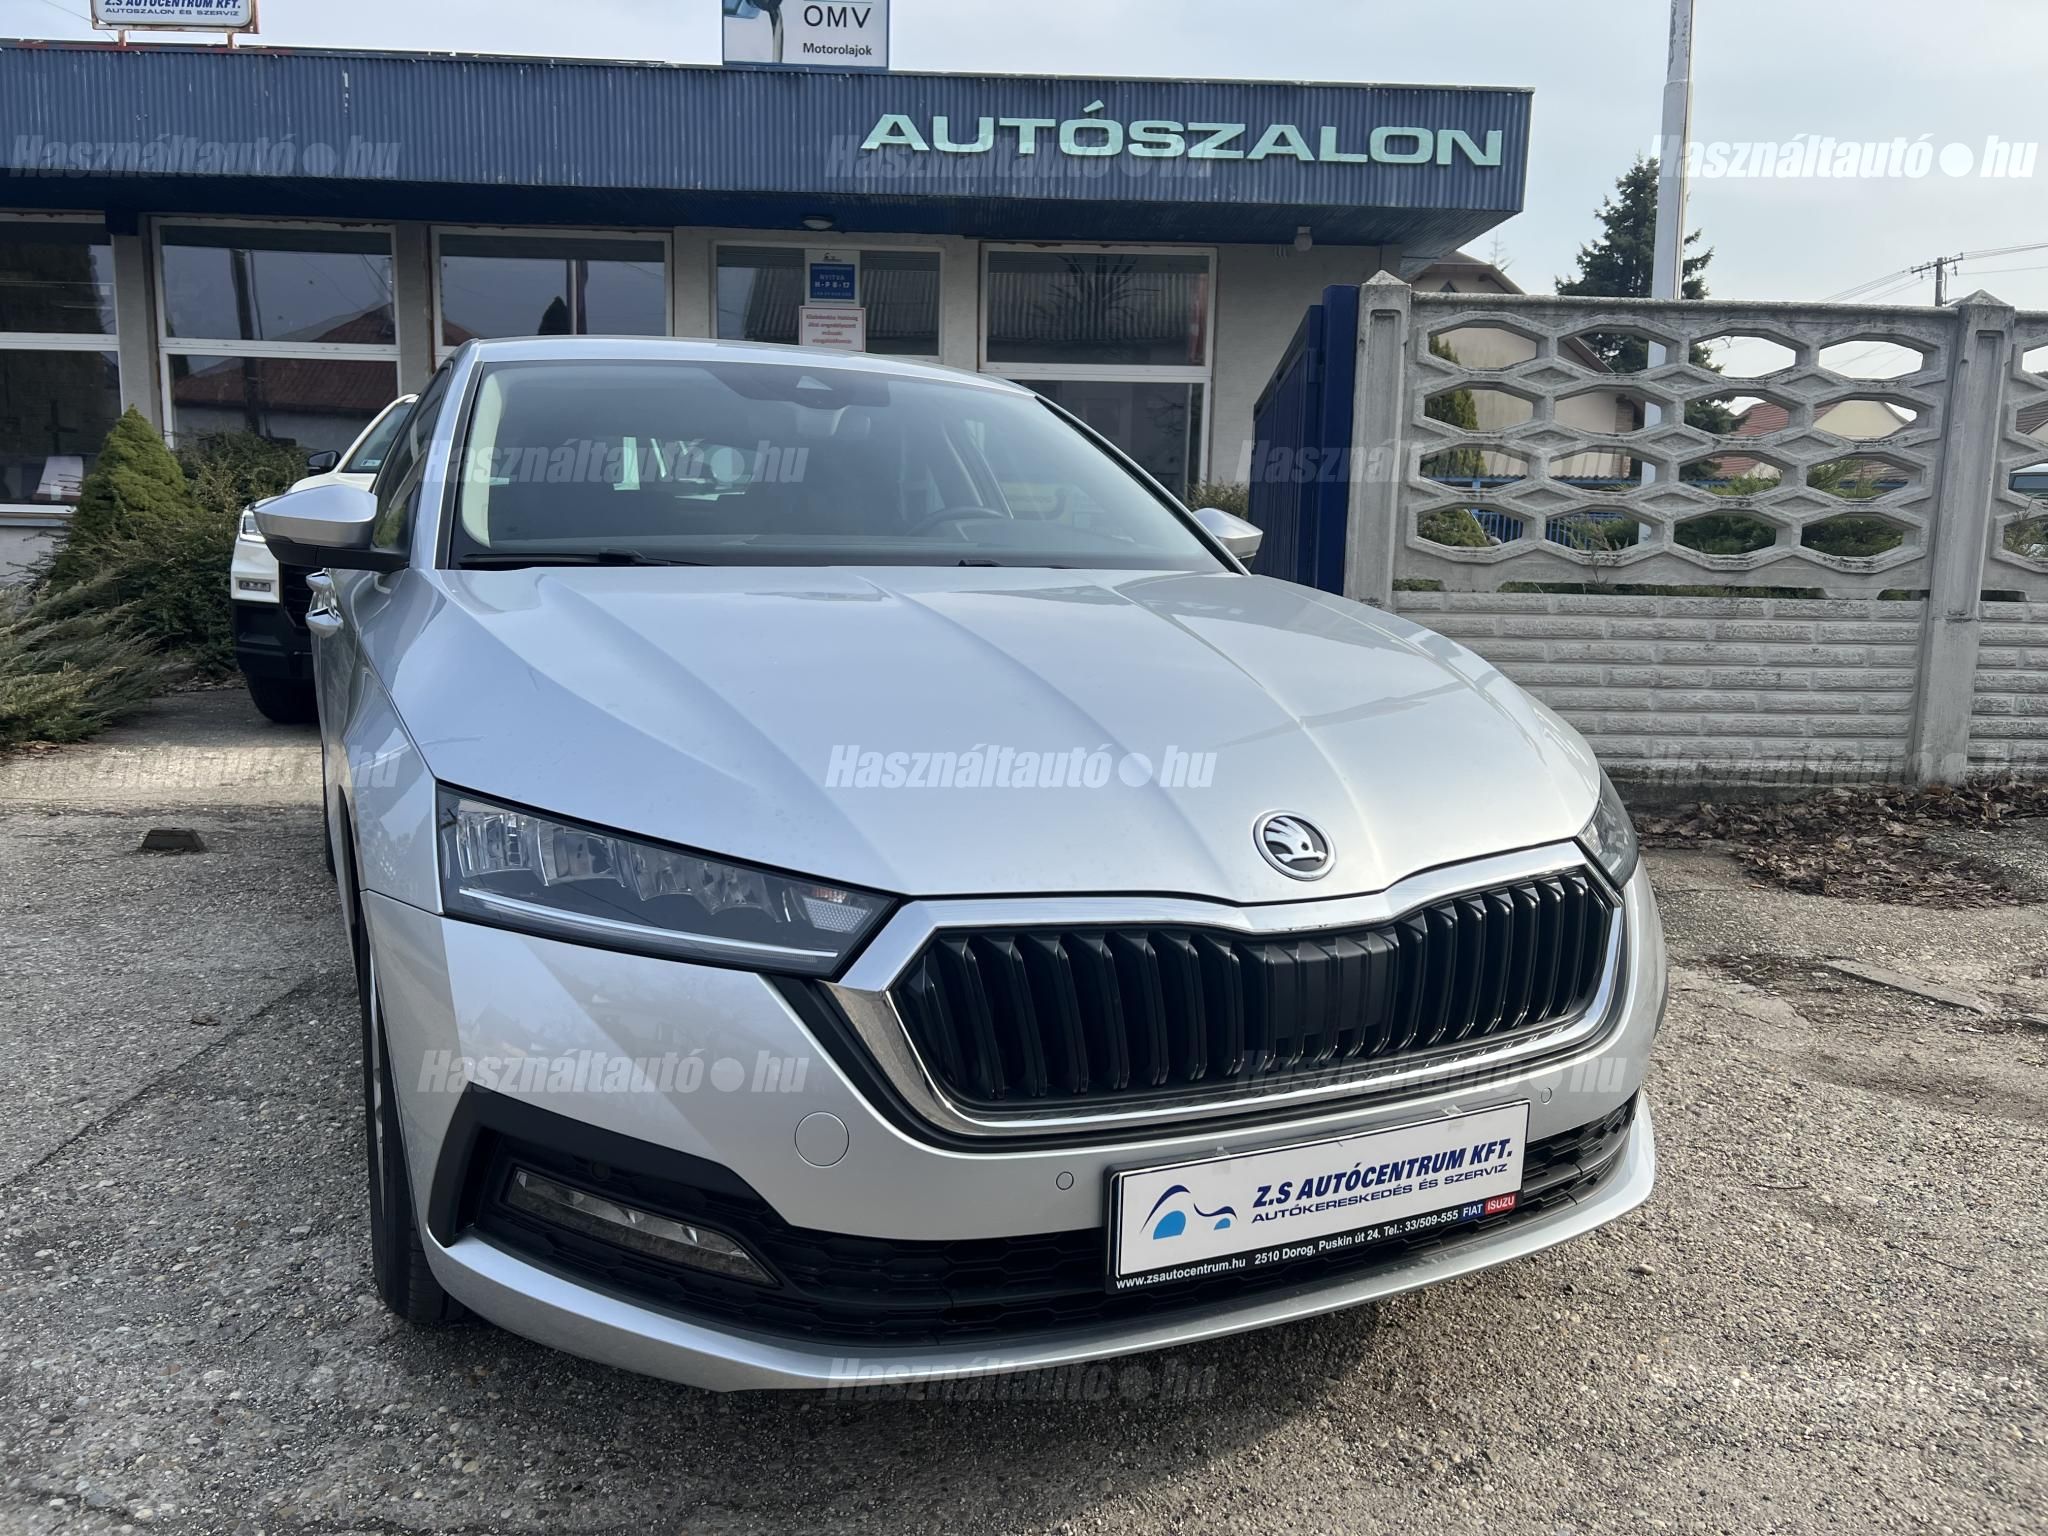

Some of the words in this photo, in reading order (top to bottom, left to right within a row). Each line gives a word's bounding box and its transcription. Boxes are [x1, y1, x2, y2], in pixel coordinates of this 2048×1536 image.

[803, 4, 872, 28] OMV
[803, 42, 873, 57] Motorolajok
[860, 99, 1503, 167] AUTÓSZALON
[1251, 1184, 1413, 1224] AUTÓKERESKEDÉS
[1418, 1178, 1439, 1191] ÉS
[1444, 1163, 1508, 1185] SZERVIZ
[1252, 1181, 1294, 1209] Z.S
[1296, 1147, 1467, 1199] AUTÓCENTRUM
[1469, 1138, 1513, 1166] KFT.
[1462, 1203, 1484, 1218] FIAT
[1487, 1195, 1516, 1210] ISUZU
[1116, 1257, 1247, 1290] www.zsautocentrum.hu
[1254, 1250, 1280, 1265] 2510
[1282, 1243, 1317, 1260] Dorog,
[1318, 1235, 1352, 1252] Puskin
[1354, 1232, 1365, 1243] út
[1366, 1229, 1382, 1241] 24.
[1383, 1224, 1404, 1237] Tel.:
[1404, 1209, 1460, 1232] 33/509-555
